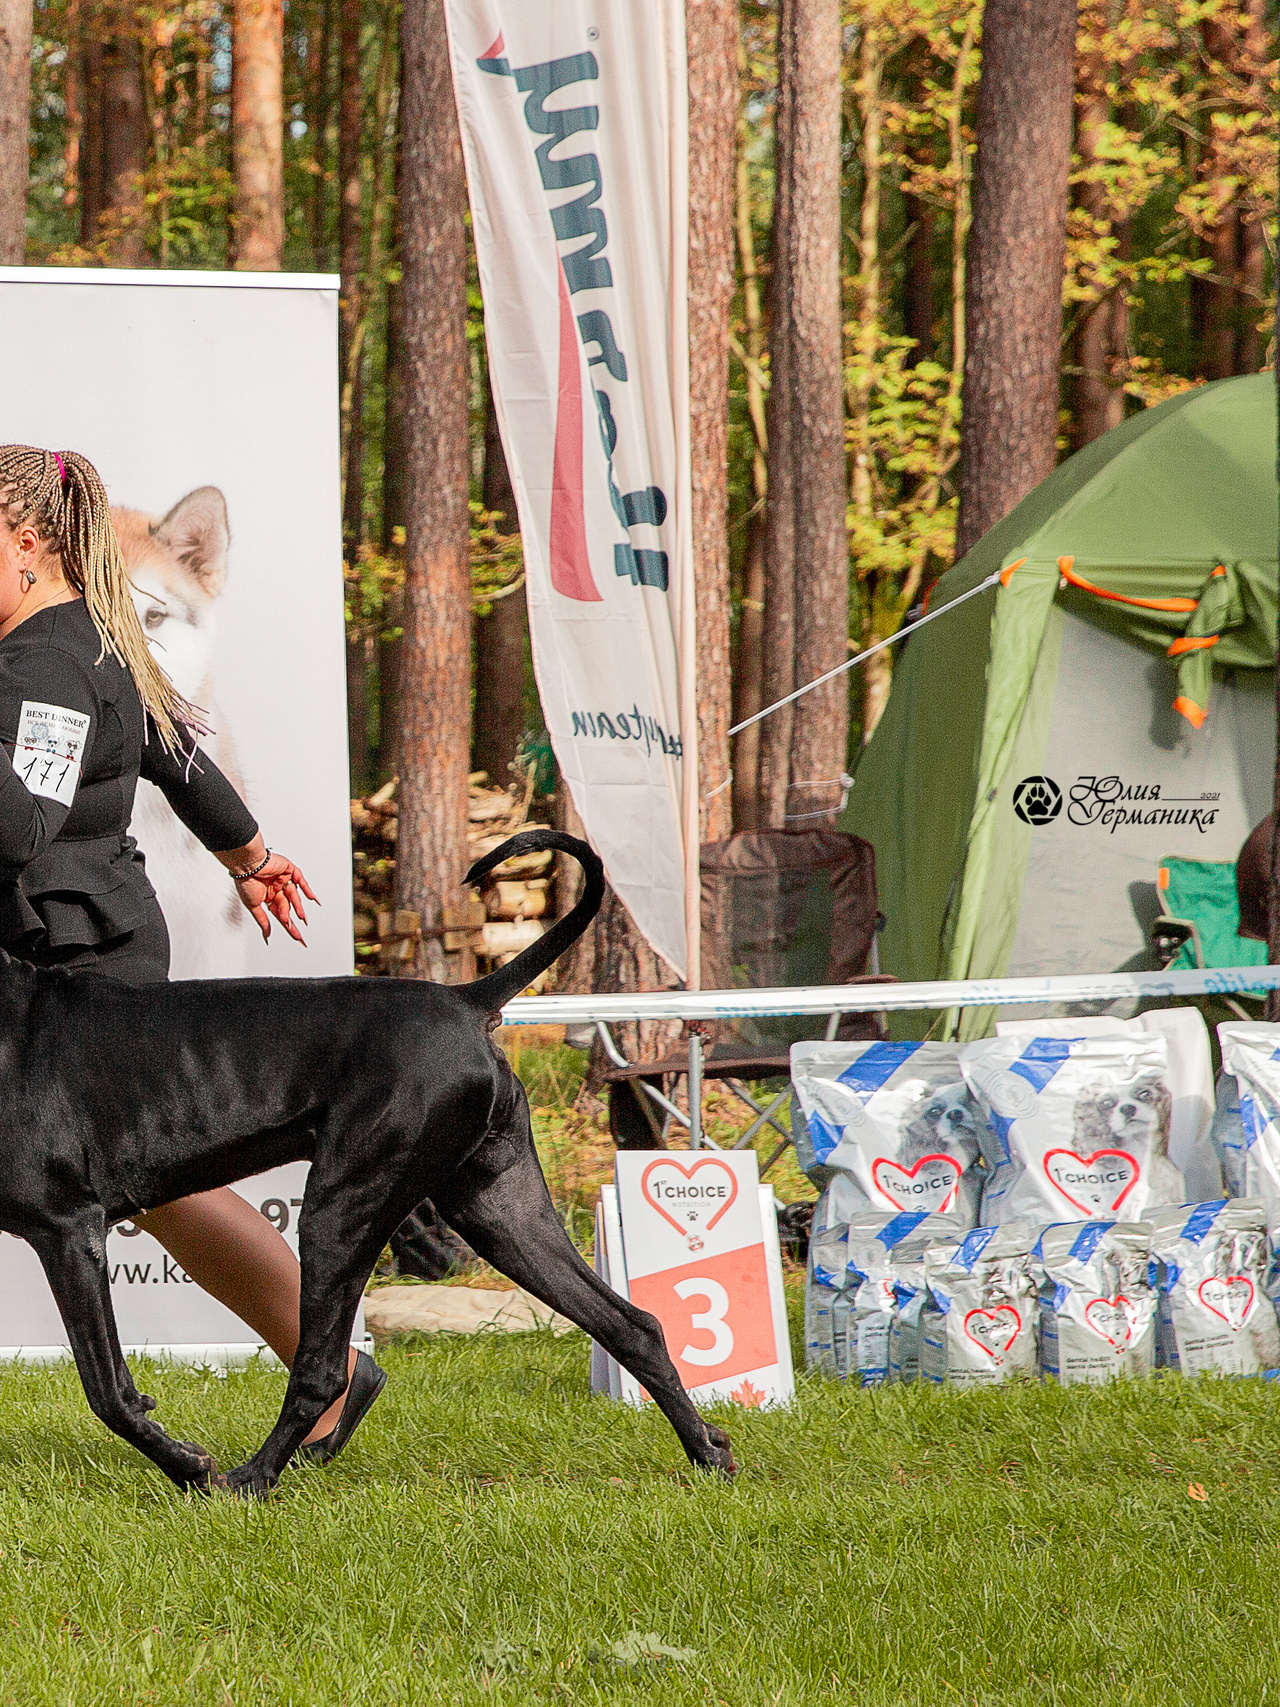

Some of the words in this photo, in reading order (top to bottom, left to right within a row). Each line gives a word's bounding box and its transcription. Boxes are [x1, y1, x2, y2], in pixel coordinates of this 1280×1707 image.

[25, 709, 51, 720] BEST
[23, 757, 70, 793] 171
[893, 1174, 953, 1195] CHOICE
[1065, 1169, 1129, 1184] CHOICE
[664, 1185, 727, 1199] CHOICE
[672, 1276, 735, 1367] 3
